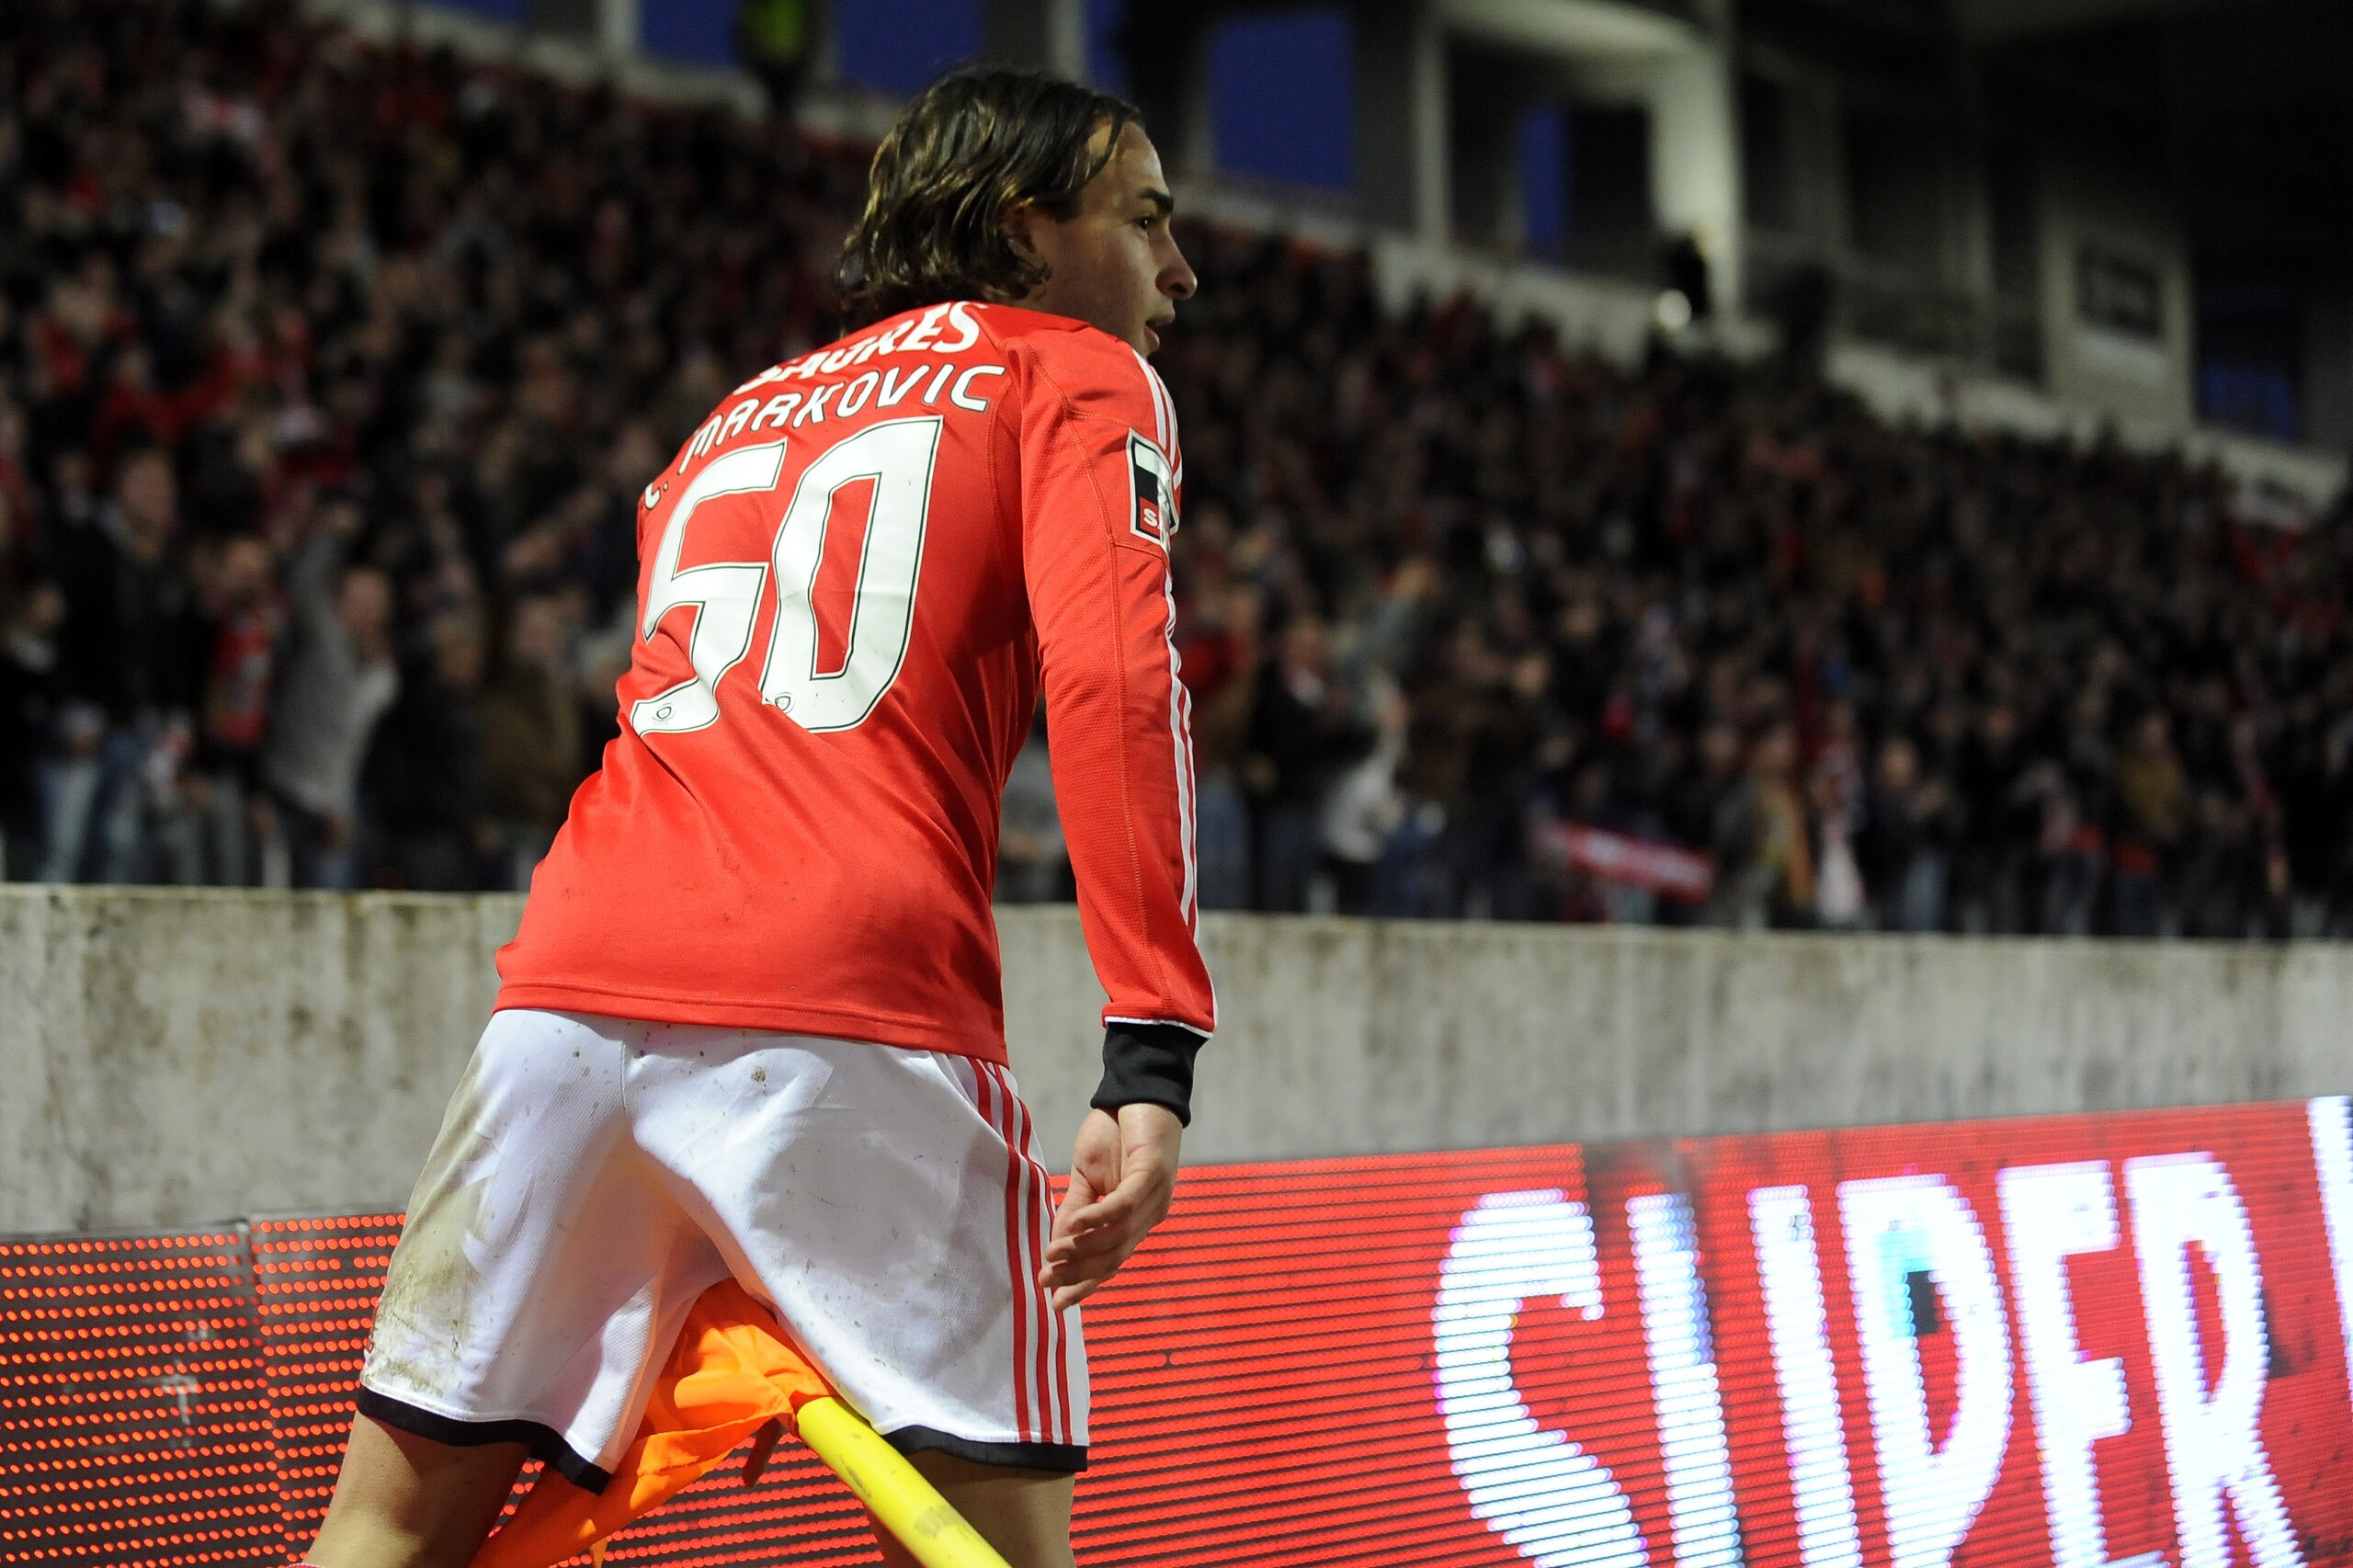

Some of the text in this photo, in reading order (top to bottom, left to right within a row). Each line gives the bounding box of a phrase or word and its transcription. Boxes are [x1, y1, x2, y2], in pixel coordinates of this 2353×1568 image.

[631, 415, 944, 736] 50
[677, 364, 1006, 475] MARKOVIC
[1433, 1152, 2311, 1568] SUPER
